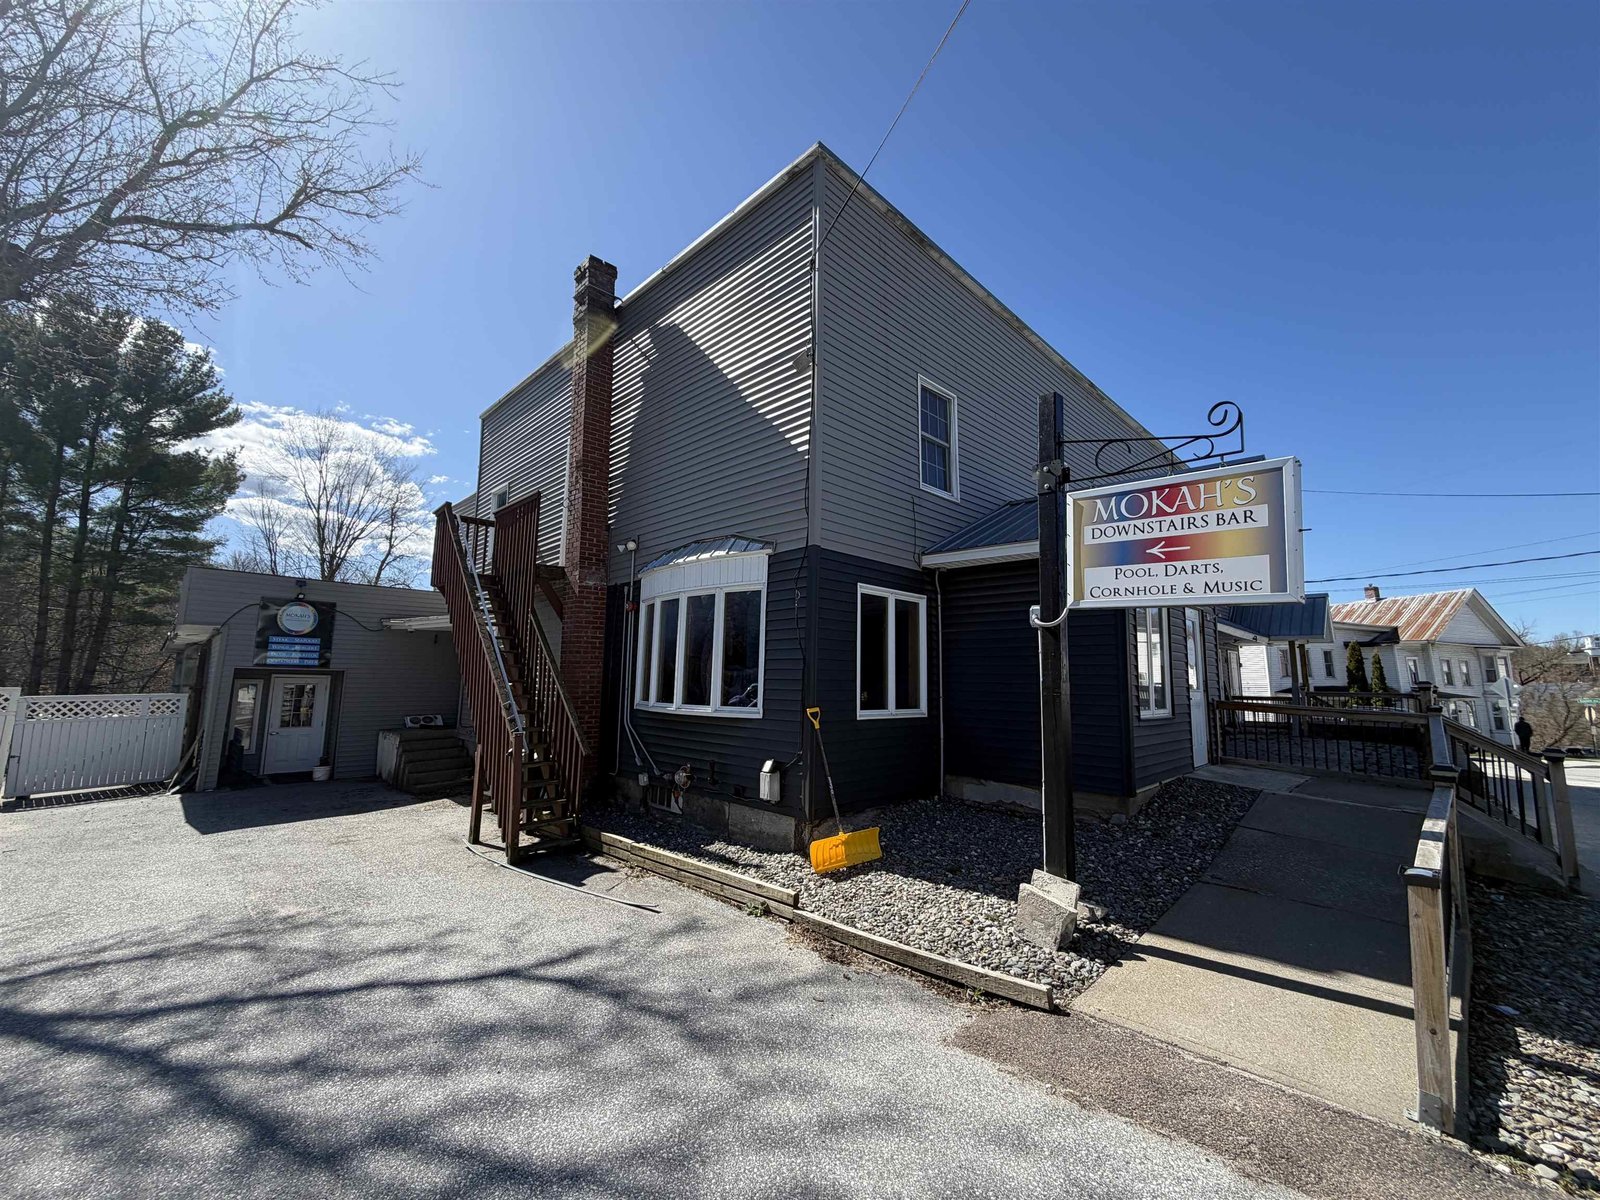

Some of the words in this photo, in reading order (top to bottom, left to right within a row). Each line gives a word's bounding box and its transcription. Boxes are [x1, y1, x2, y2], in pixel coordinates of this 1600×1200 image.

[1092, 475, 1257, 523] MOKAH'S
[1091, 514, 1209, 540] DOWNSTAIRS
[1216, 509, 1258, 527] BAR
[1114, 567, 1158, 580] POOL,
[1164, 562, 1224, 577] DARTS,
[1089, 584, 1177, 598] CORNHOLE
[1182, 582, 1196, 594] &
[1203, 580, 1263, 594] MUSIC
